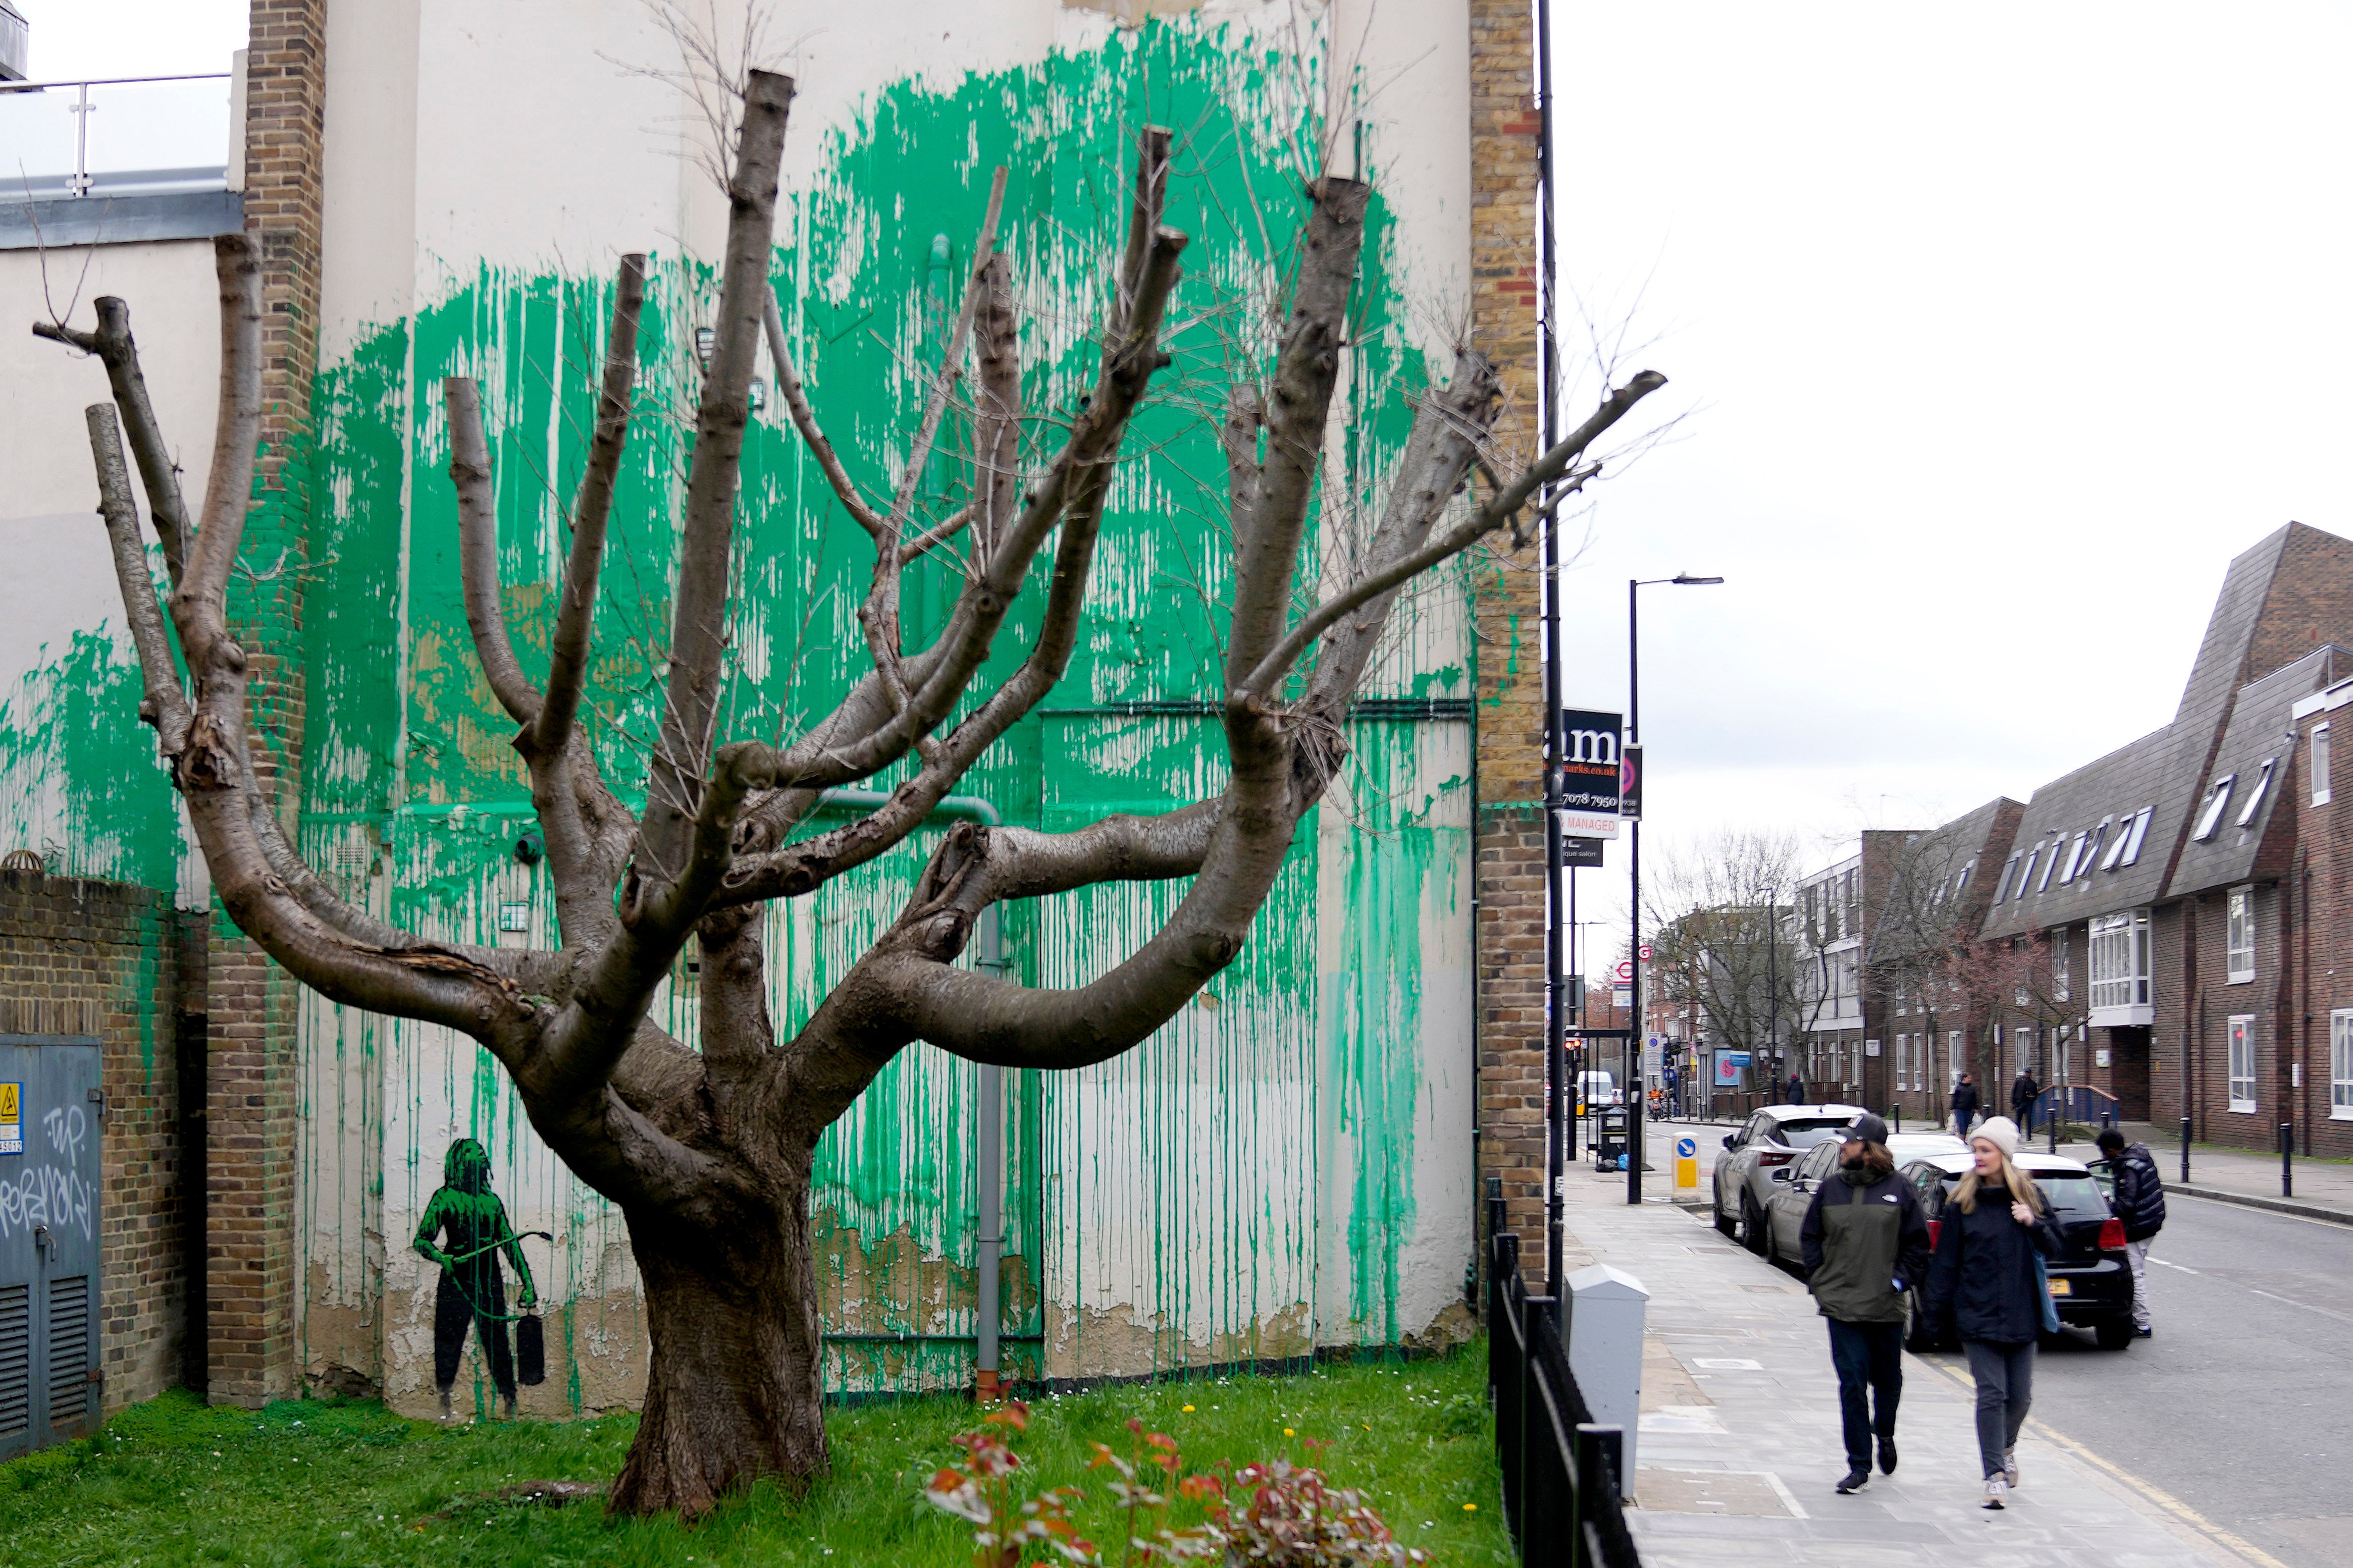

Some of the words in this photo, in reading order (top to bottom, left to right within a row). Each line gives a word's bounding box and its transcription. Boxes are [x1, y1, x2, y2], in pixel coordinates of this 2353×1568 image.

[1562, 792, 1590, 805] 7078
[1590, 795, 1618, 807] 7950
[1567, 817, 1615, 832] MANAGED
[1639, 947, 1650, 958] G
